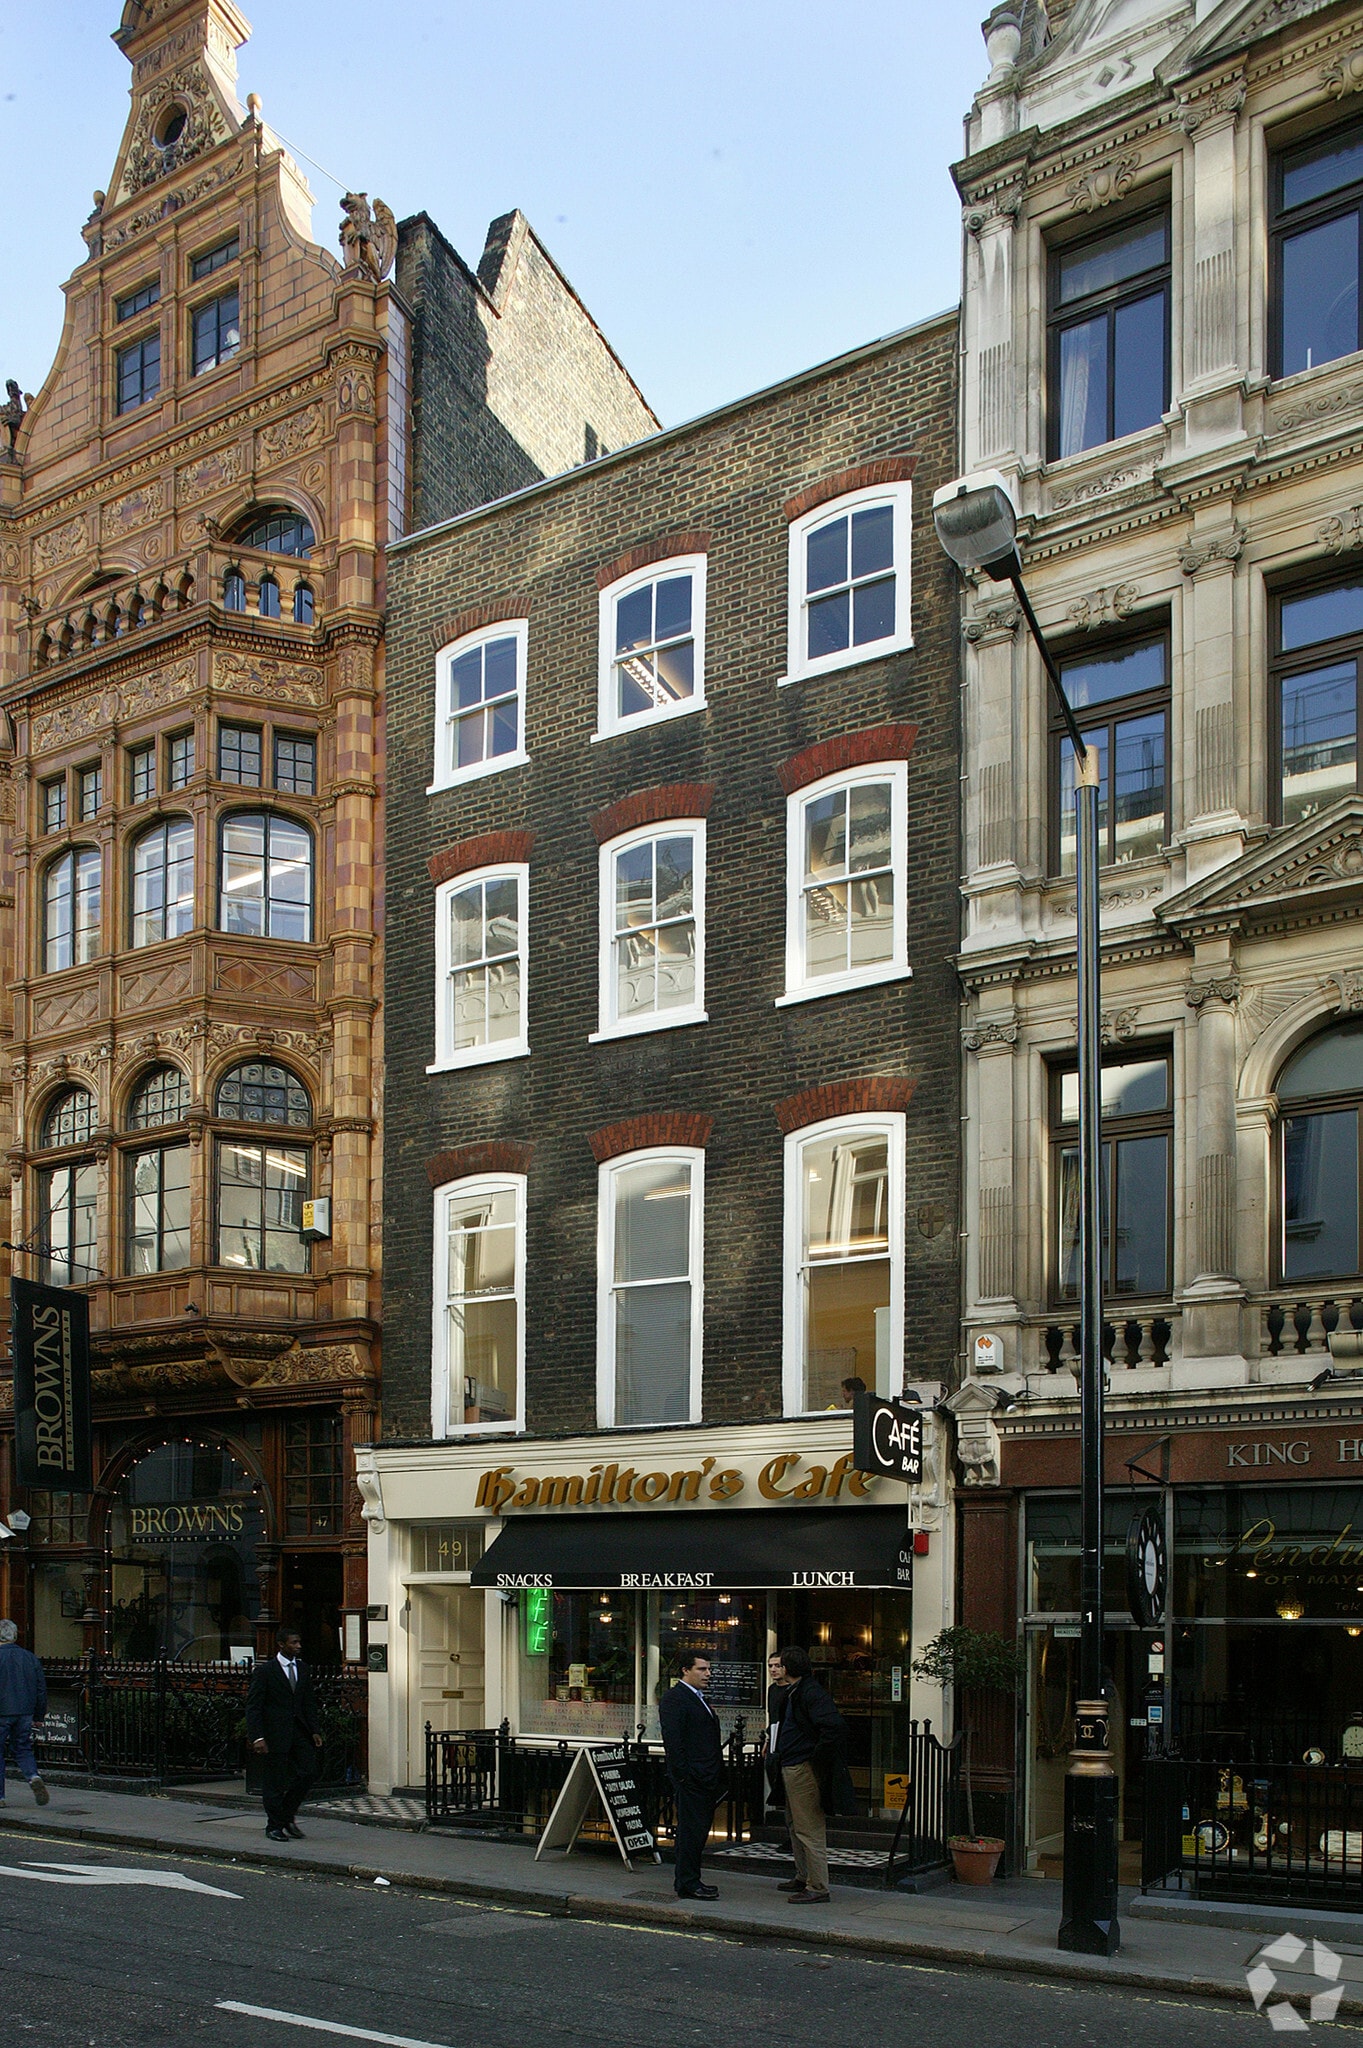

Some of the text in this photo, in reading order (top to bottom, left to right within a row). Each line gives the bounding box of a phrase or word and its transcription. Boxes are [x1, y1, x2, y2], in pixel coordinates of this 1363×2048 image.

[307, 463, 321, 484] 2
[63, 1316, 71, 1343] BAR
[32, 1304, 64, 1471] BROWNS
[65, 1368, 74, 1466] RESTAURANT
[872, 1407, 920, 1467] CAFÉ
[1226, 1438, 1363, 1467] KING H
[901, 1456, 920, 1474] BAR
[474, 1455, 746, 1516] Hamilton's
[130, 1503, 244, 1535] BROWNS
[315, 1515, 329, 1528] 47
[437, 1541, 463, 1557] 49
[496, 1573, 553, 1587] SNACKS
[620, 1571, 714, 1588] BREAKFAST
[791, 1570, 856, 1587] LUNCH
[897, 1567, 910, 1581] BAR
[1264, 1574, 1295, 1585] OF
[1085, 1611, 1094, 1623] 1
[627, 1834, 650, 1849] OPEN
